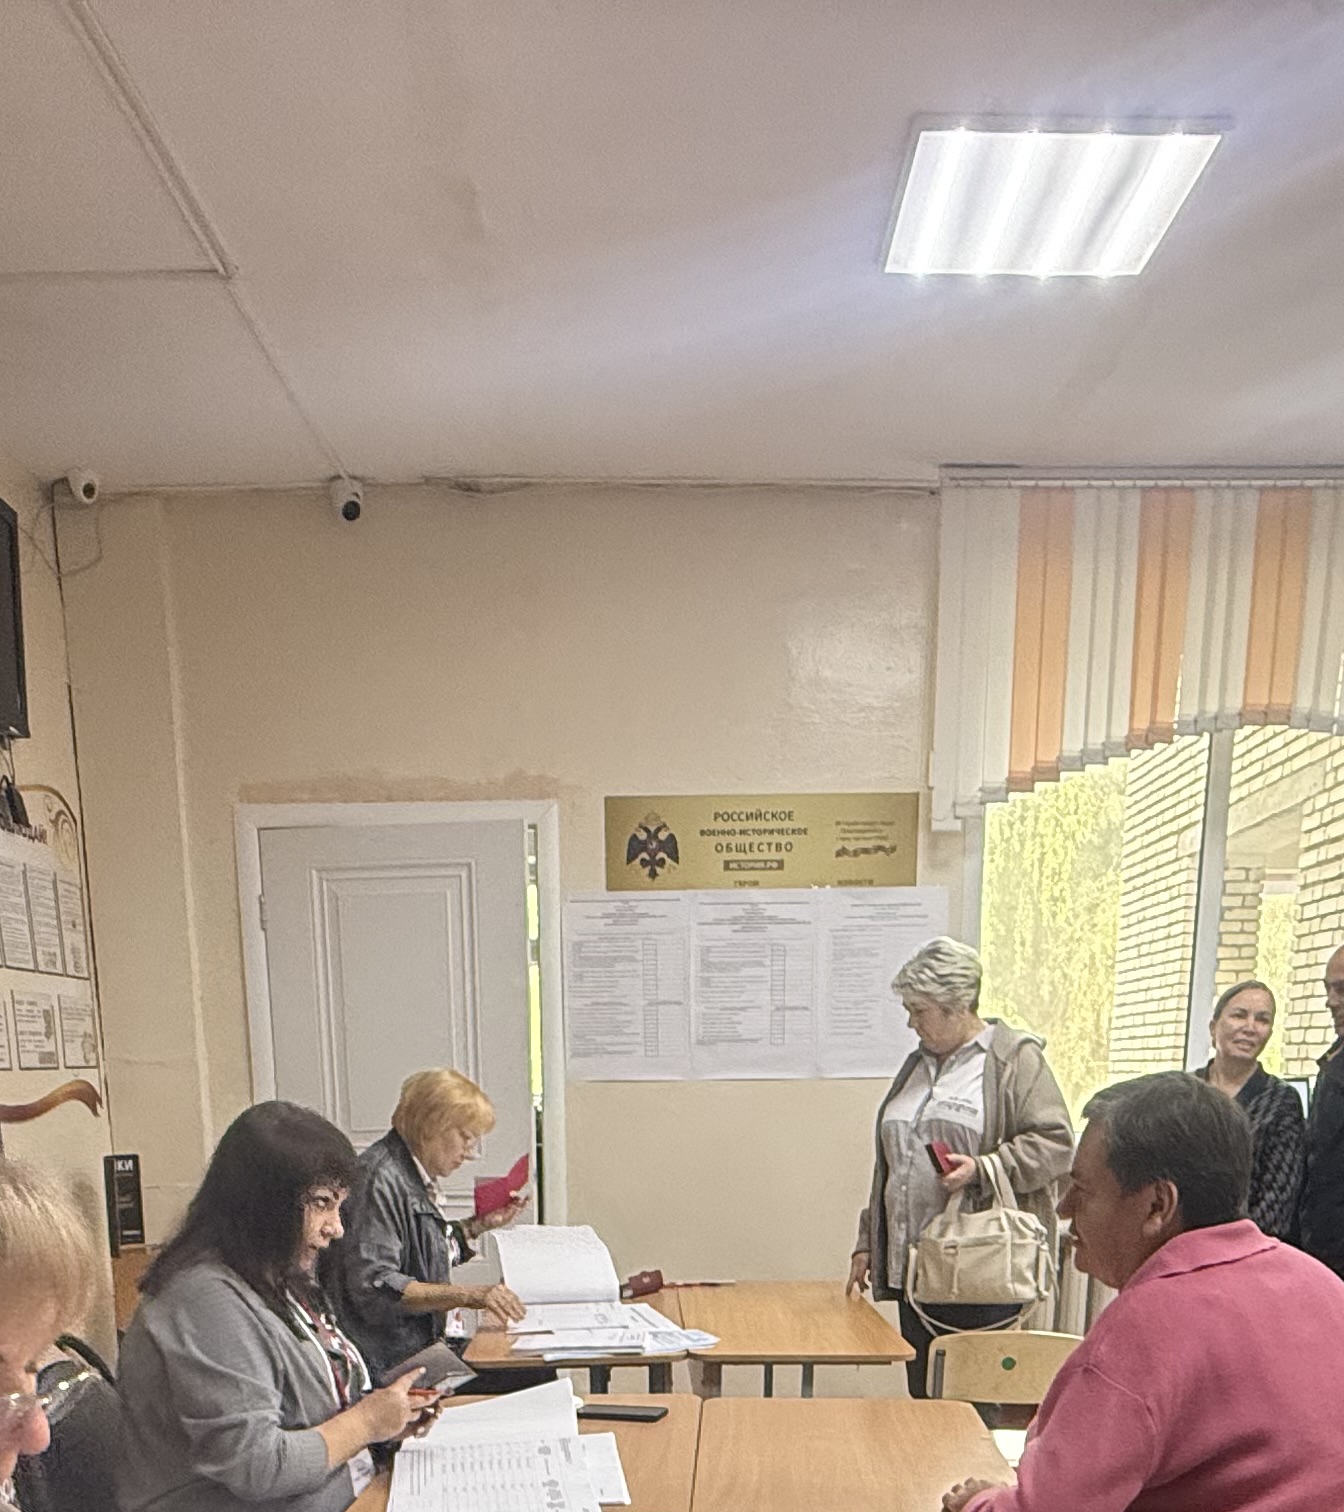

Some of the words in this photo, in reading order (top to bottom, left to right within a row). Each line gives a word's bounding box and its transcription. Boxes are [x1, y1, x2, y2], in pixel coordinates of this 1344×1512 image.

[713, 808, 795, 822] РОССИЙСКОЕ
[699, 827, 809, 837] ВОЕННО-ИСТОРИЧЕСКОЕ
[714, 842, 794, 855] ОБЩЕСТВО
